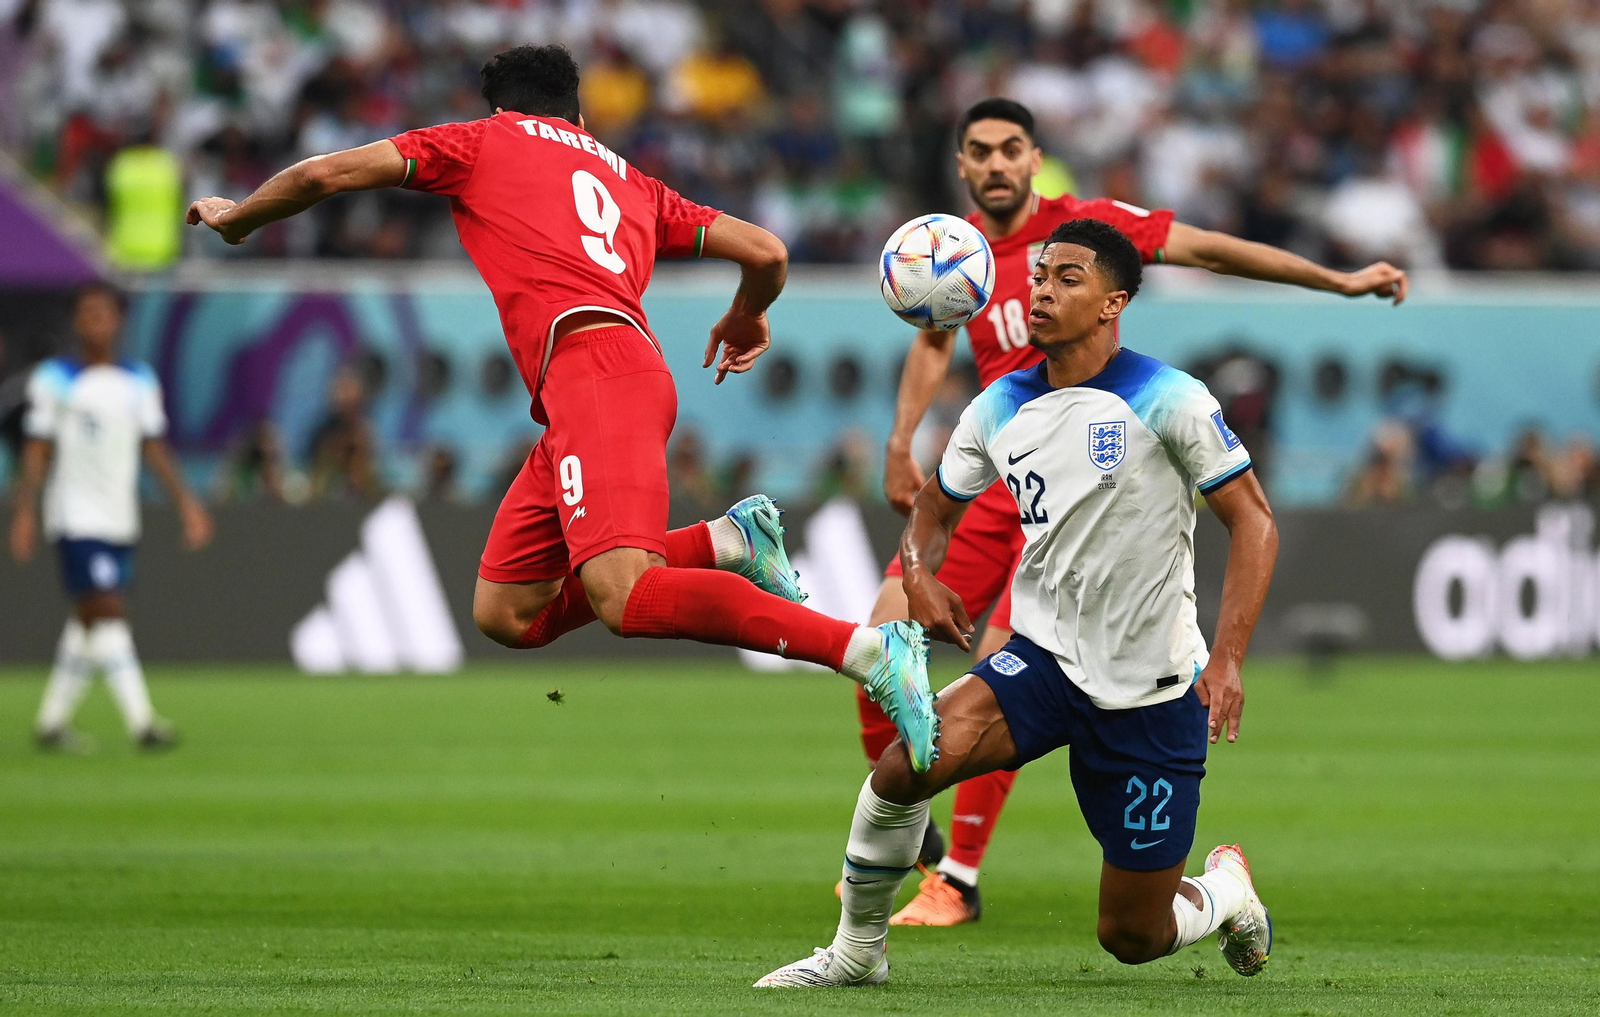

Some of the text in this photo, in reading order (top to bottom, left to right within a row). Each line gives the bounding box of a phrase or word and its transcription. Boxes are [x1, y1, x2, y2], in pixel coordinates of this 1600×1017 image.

[516, 119, 627, 181] TAREMI
[571, 169, 627, 275] 9
[987, 298, 1029, 353] 18
[559, 454, 584, 507] 9
[1006, 469, 1049, 525] 22
[1411, 503, 1600, 660] adi
[1123, 775, 1173, 831] 22
